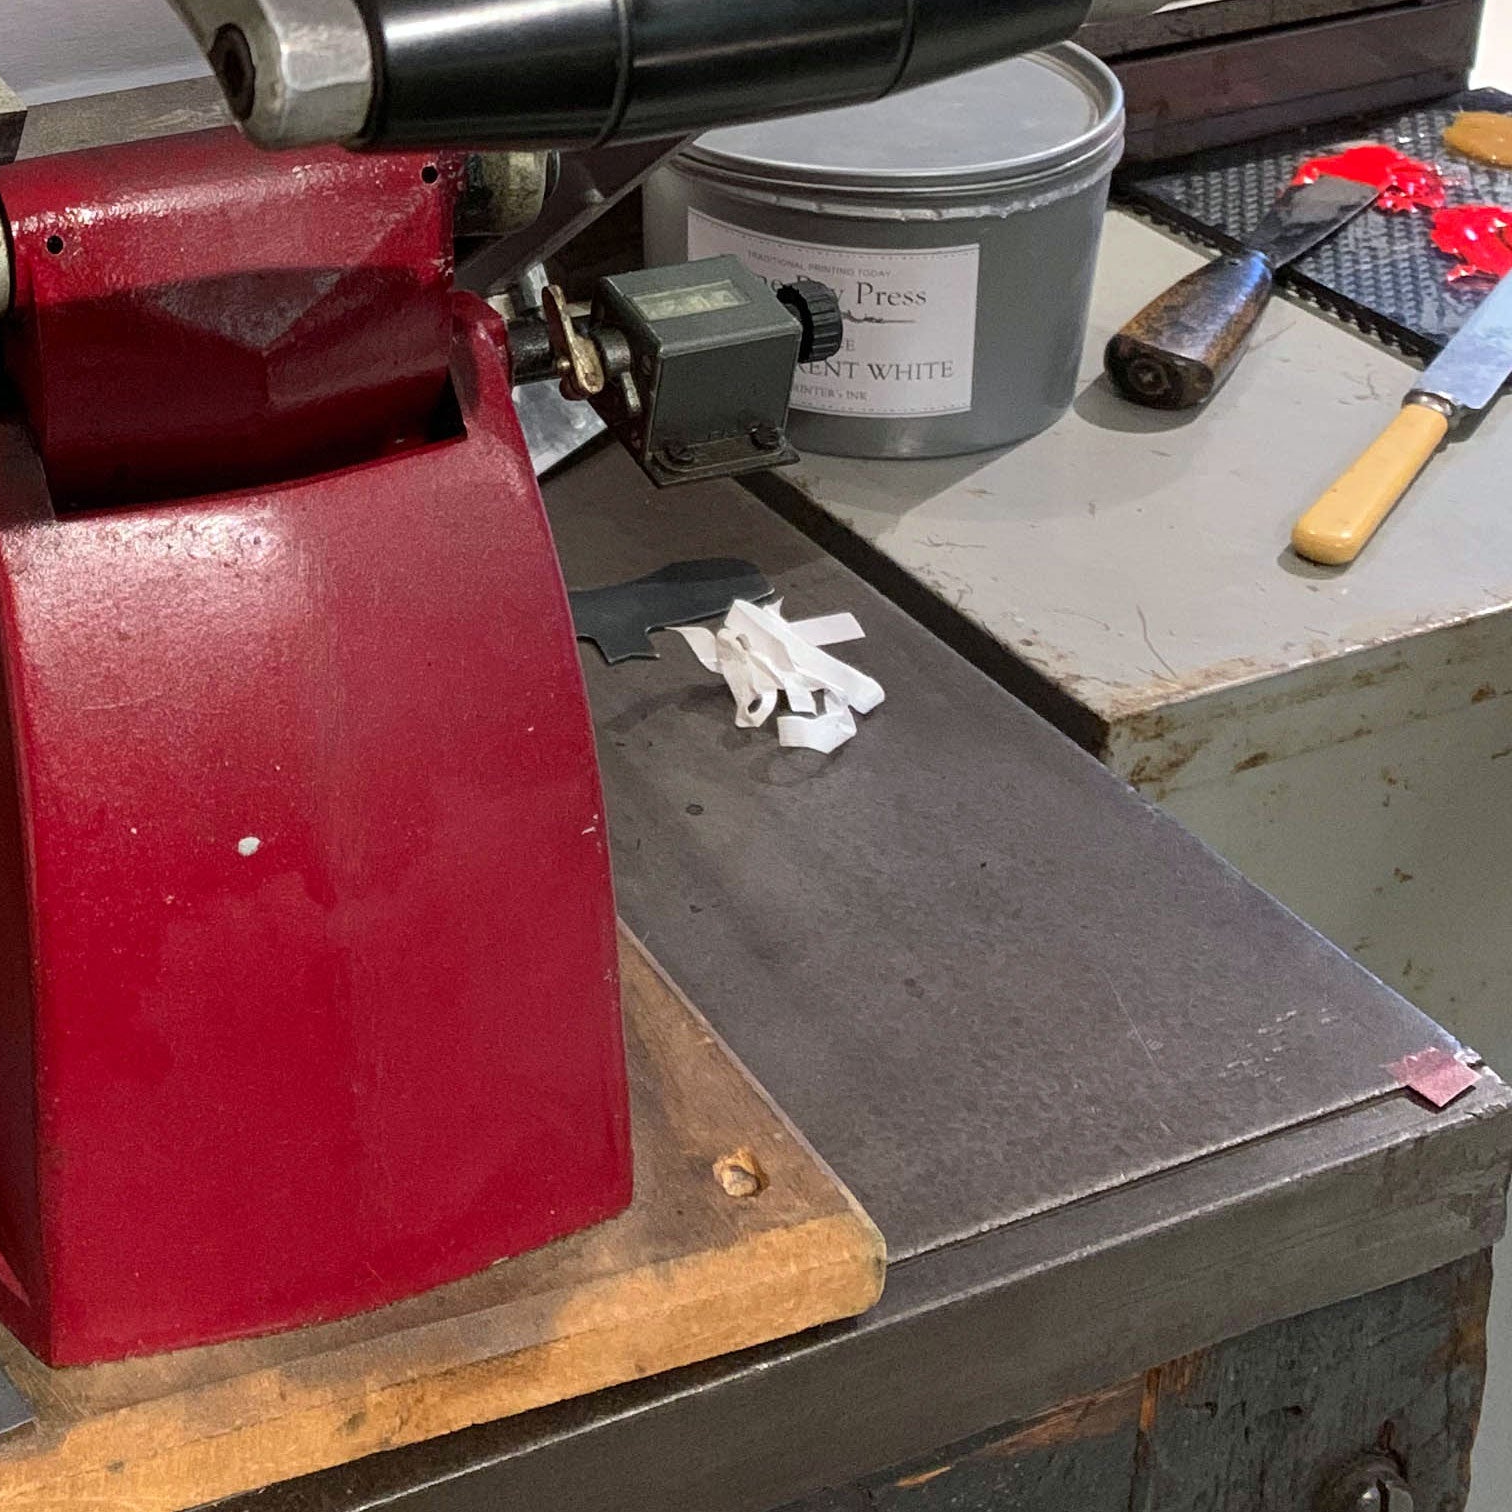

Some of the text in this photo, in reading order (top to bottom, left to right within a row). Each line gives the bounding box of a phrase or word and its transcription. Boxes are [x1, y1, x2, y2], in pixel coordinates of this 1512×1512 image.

[747, 249, 892, 278] TRADITIONAL PRINTING TODAY
[855, 280, 928, 307] Press
[867, 360, 955, 381] WHITE
[845, 389, 869, 401] INK
